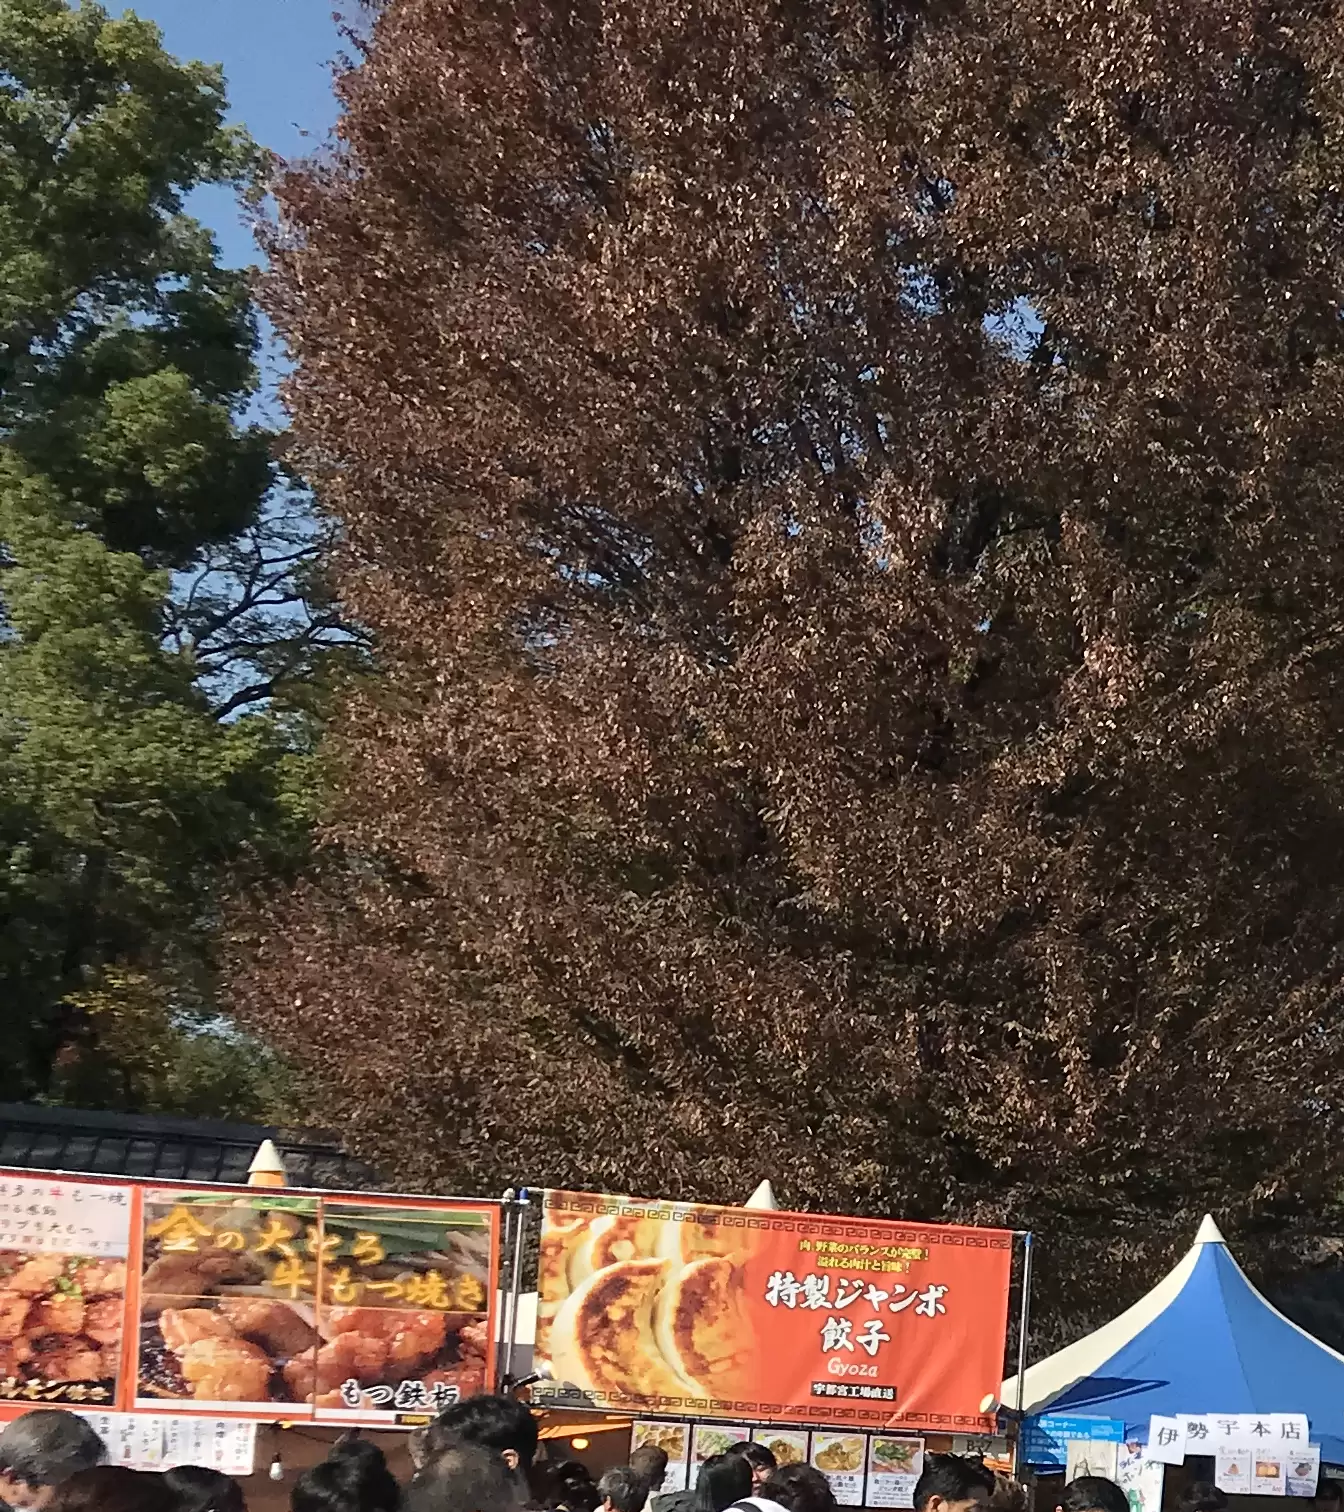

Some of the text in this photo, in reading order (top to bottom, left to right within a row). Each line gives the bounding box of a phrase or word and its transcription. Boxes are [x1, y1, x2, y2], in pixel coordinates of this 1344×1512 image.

[149, 1205, 386, 1267] 金の大とろ
[272, 1254, 484, 1311] 牛もつ焼き
[765, 1271, 949, 1317] 特製ジャンボ
[820, 1316, 891, 1356] 餃子
[827, 1357, 879, 1377] Gyoza
[812, 1383, 895, 1400] 宇都宮工場直送
